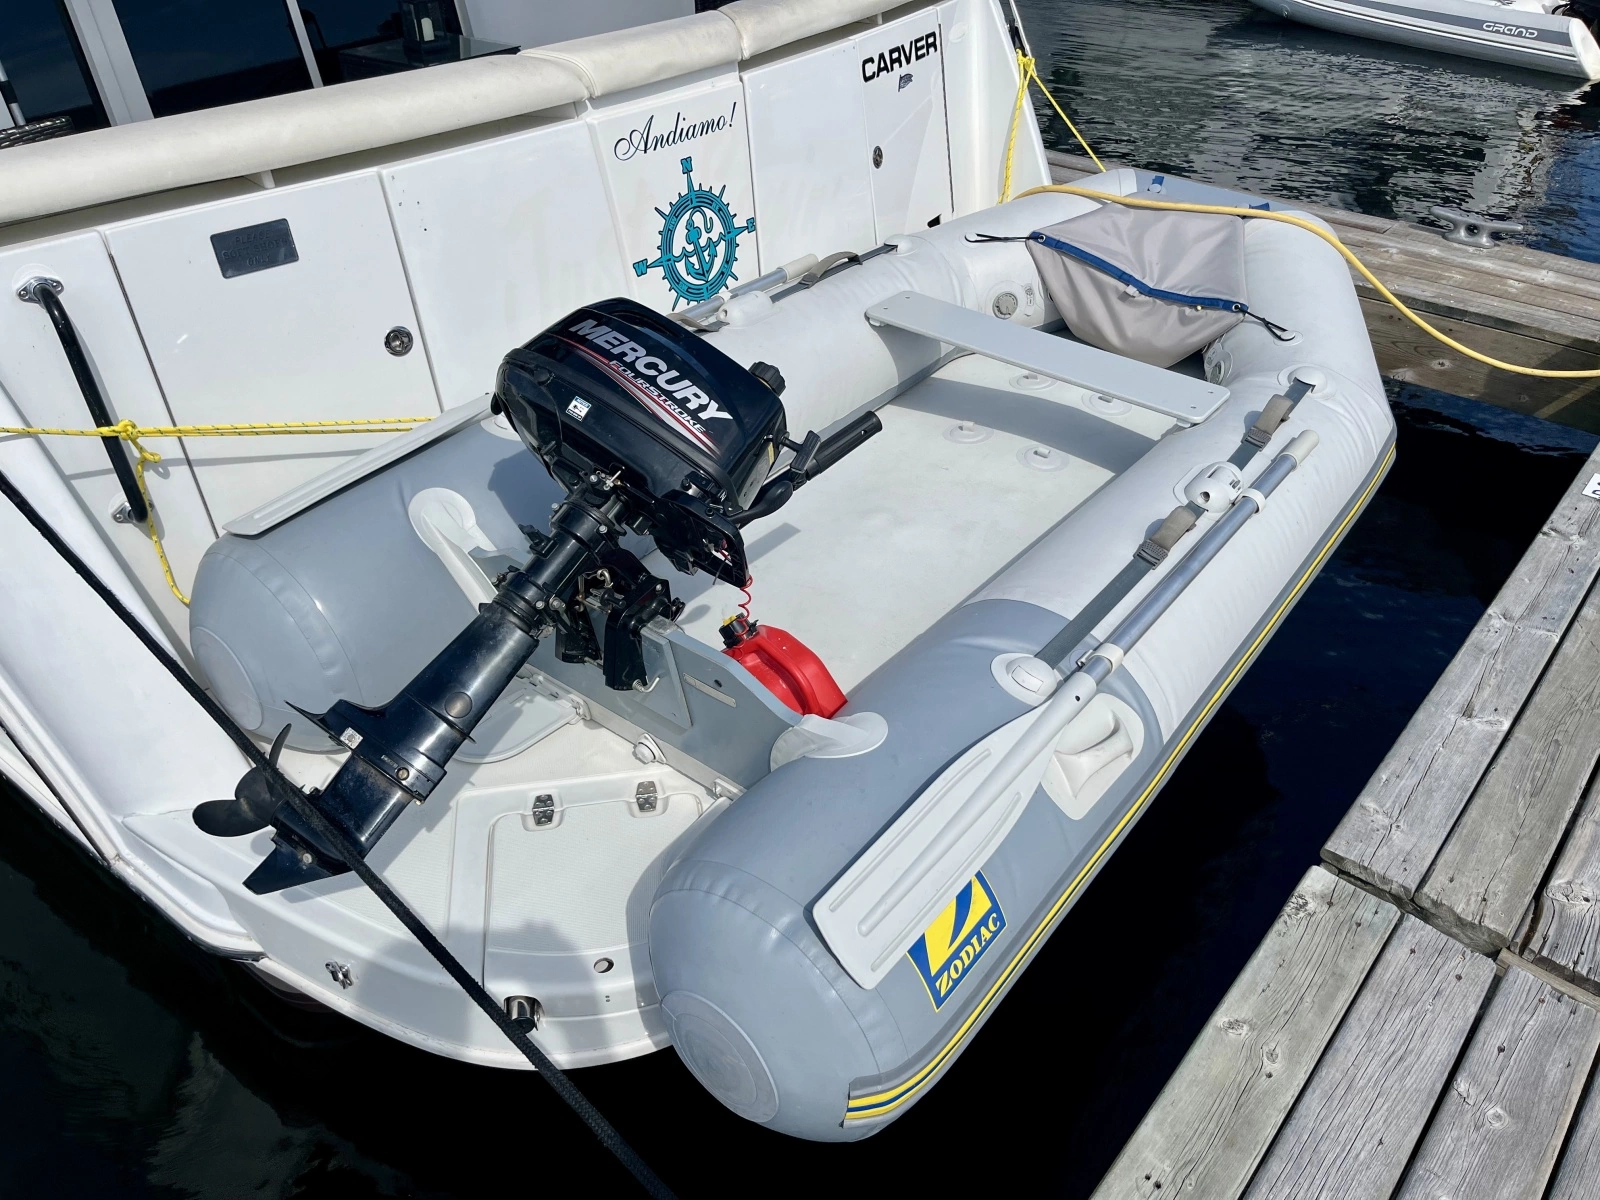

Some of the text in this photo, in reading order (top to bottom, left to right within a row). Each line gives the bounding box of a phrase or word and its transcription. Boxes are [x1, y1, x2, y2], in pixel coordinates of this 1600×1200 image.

[1483, 22, 1538, 38] GRAND
[862, 31, 937, 83] CARVER
[614, 101, 737, 161] Andiamo!
[680, 156, 693, 174] N
[235, 230, 272, 245] PLEASE
[746, 217, 756, 233] E
[633, 258, 648, 277] W
[568, 319, 733, 420] MERCURY
[609, 360, 706, 433] FOURSTROKE
[935, 912, 1000, 998] ZODIAC
